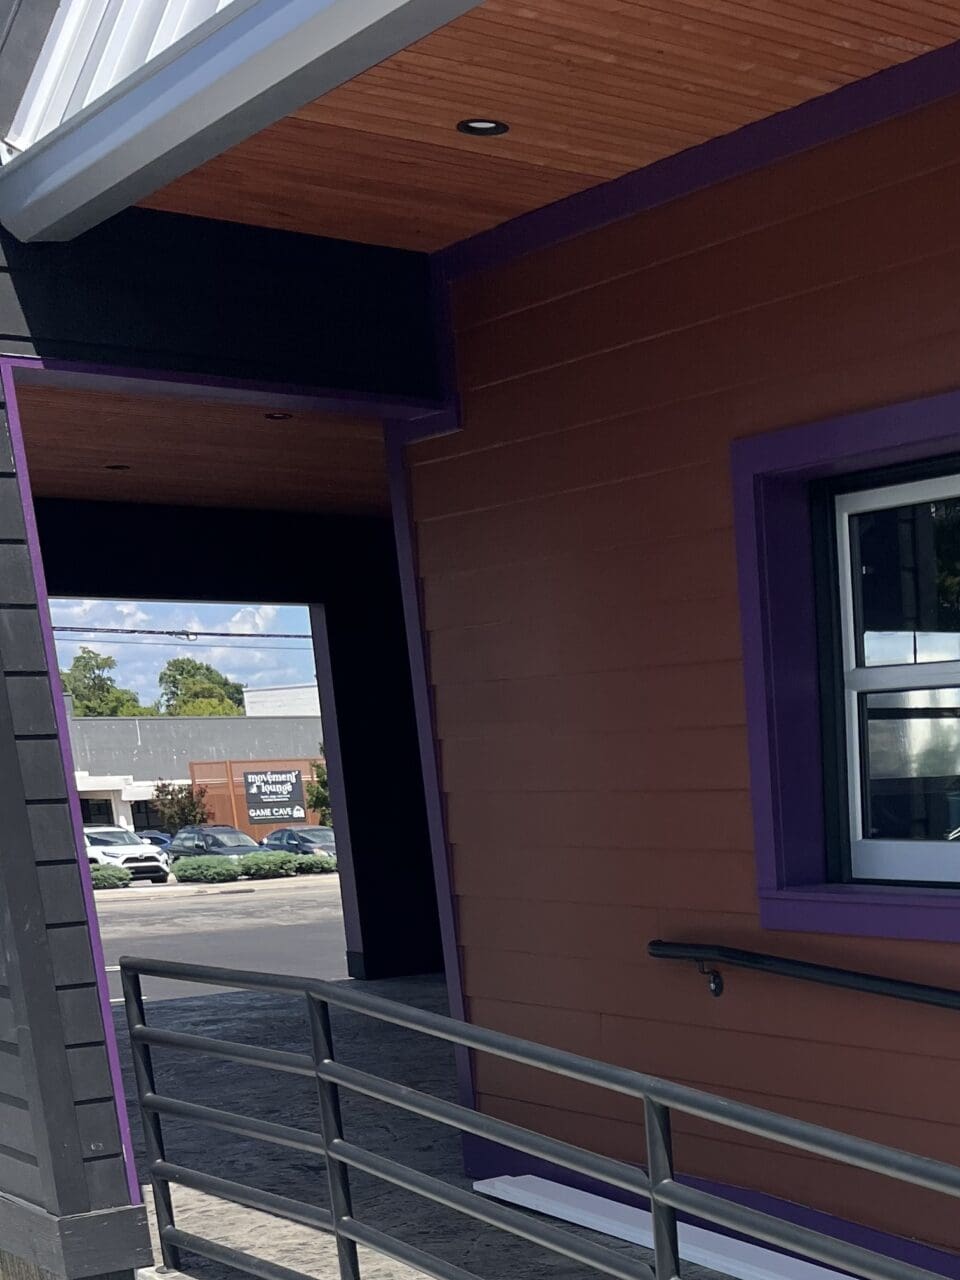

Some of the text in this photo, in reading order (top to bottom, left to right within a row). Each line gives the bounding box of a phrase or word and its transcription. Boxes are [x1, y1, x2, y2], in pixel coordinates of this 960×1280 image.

[261, 782, 292, 794] lounge
[249, 807, 292, 816] GAME CAVE
